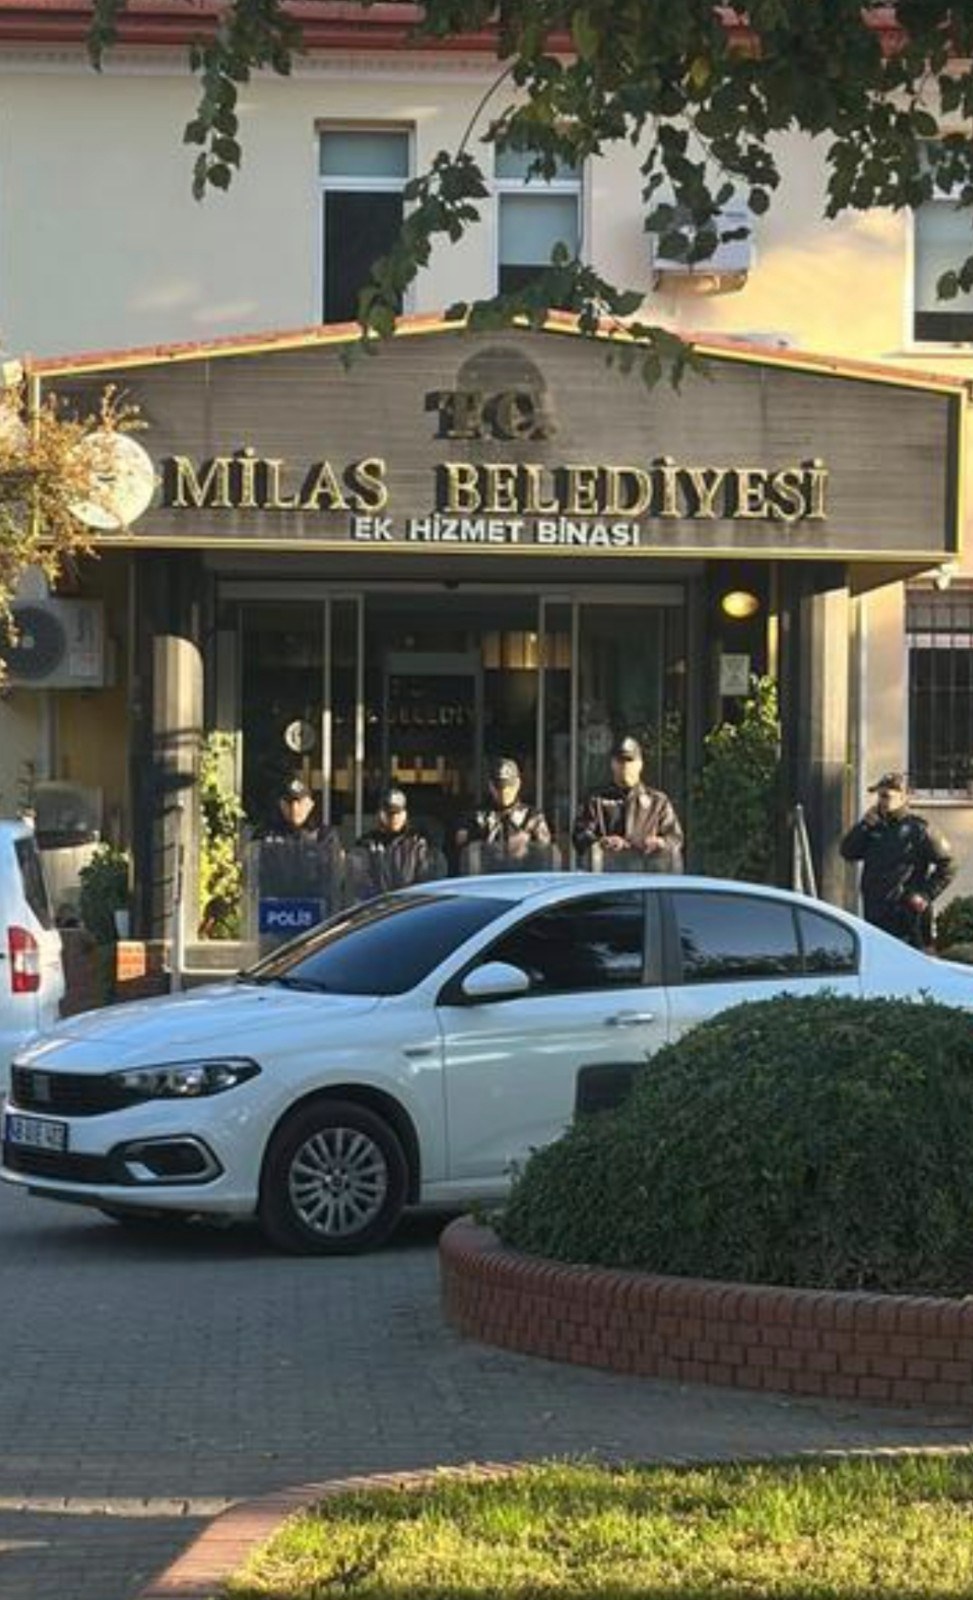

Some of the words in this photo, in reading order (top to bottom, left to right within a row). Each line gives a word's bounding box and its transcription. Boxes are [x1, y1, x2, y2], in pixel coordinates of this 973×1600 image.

[170, 447, 389, 511] MİLAS
[443, 455, 829, 520] BELEDİYESİ
[353, 517, 393, 540] EK
[410, 513, 524, 542] HİZMET
[537, 517, 640, 545] BİNASI
